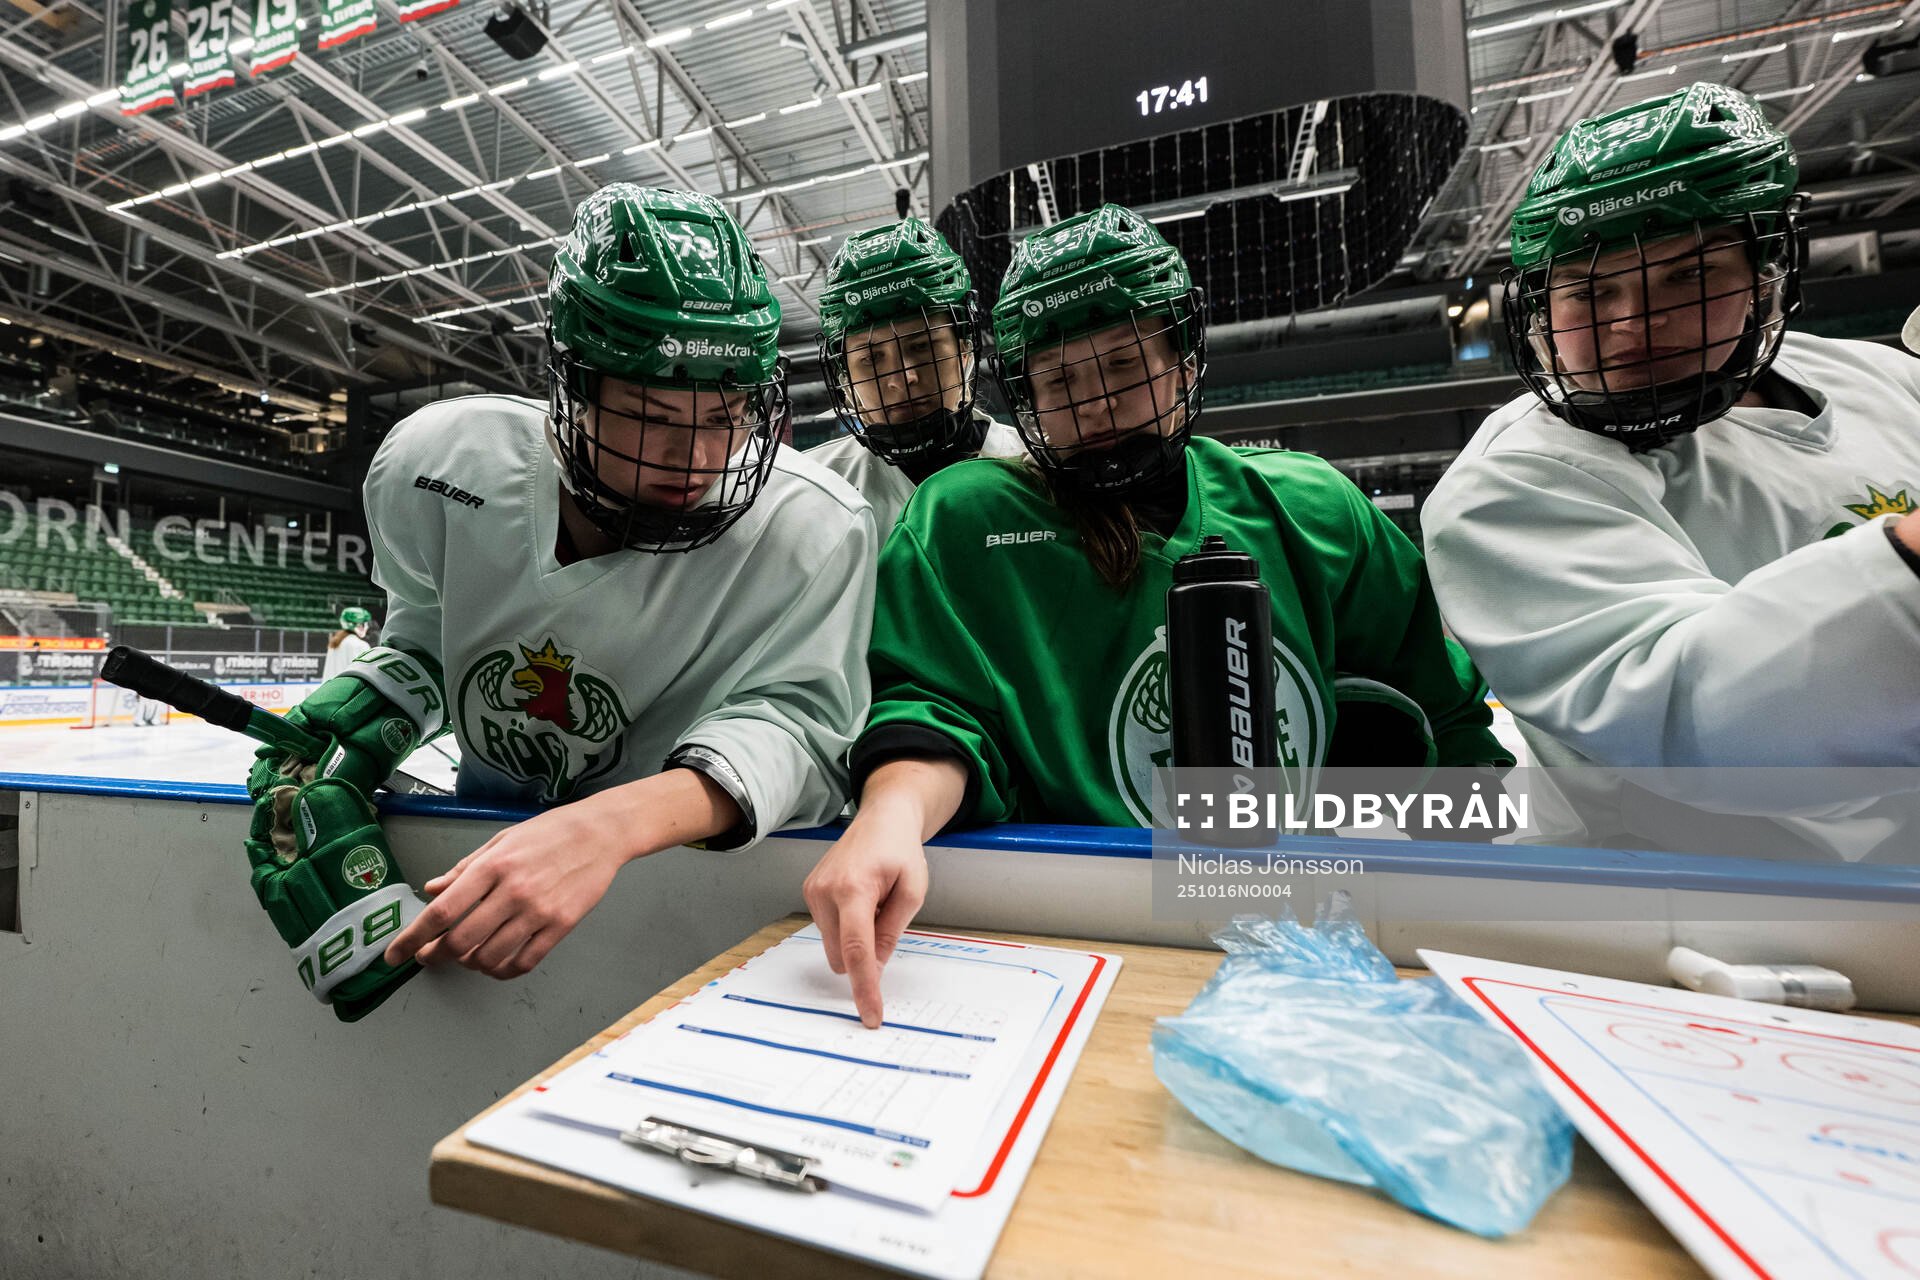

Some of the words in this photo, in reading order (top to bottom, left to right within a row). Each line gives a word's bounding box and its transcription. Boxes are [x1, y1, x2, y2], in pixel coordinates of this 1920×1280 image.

[188, 0, 232, 59] 25
[127, 19, 169, 83] 26
[1136, 76, 1208, 116] 17:41
[1589, 195, 1634, 219] Bjäre
[1635, 180, 1688, 203] Kraft
[682, 300, 733, 312] BAUER
[862, 285, 888, 301] Bjäre
[888, 277, 916, 293] Kraft
[1045, 289, 1079, 310] Bjäre
[1079, 274, 1117, 297] Kraft
[686, 340, 724, 358] Bjäre
[414, 476, 485, 510] BAUER
[153, 515, 367, 575] CENTER
[986, 530, 1057, 548] BAUER
[1225, 617, 1254, 770] BAUER
[480, 714, 601, 798] RÖG
[897, 937, 990, 955] BAUE
